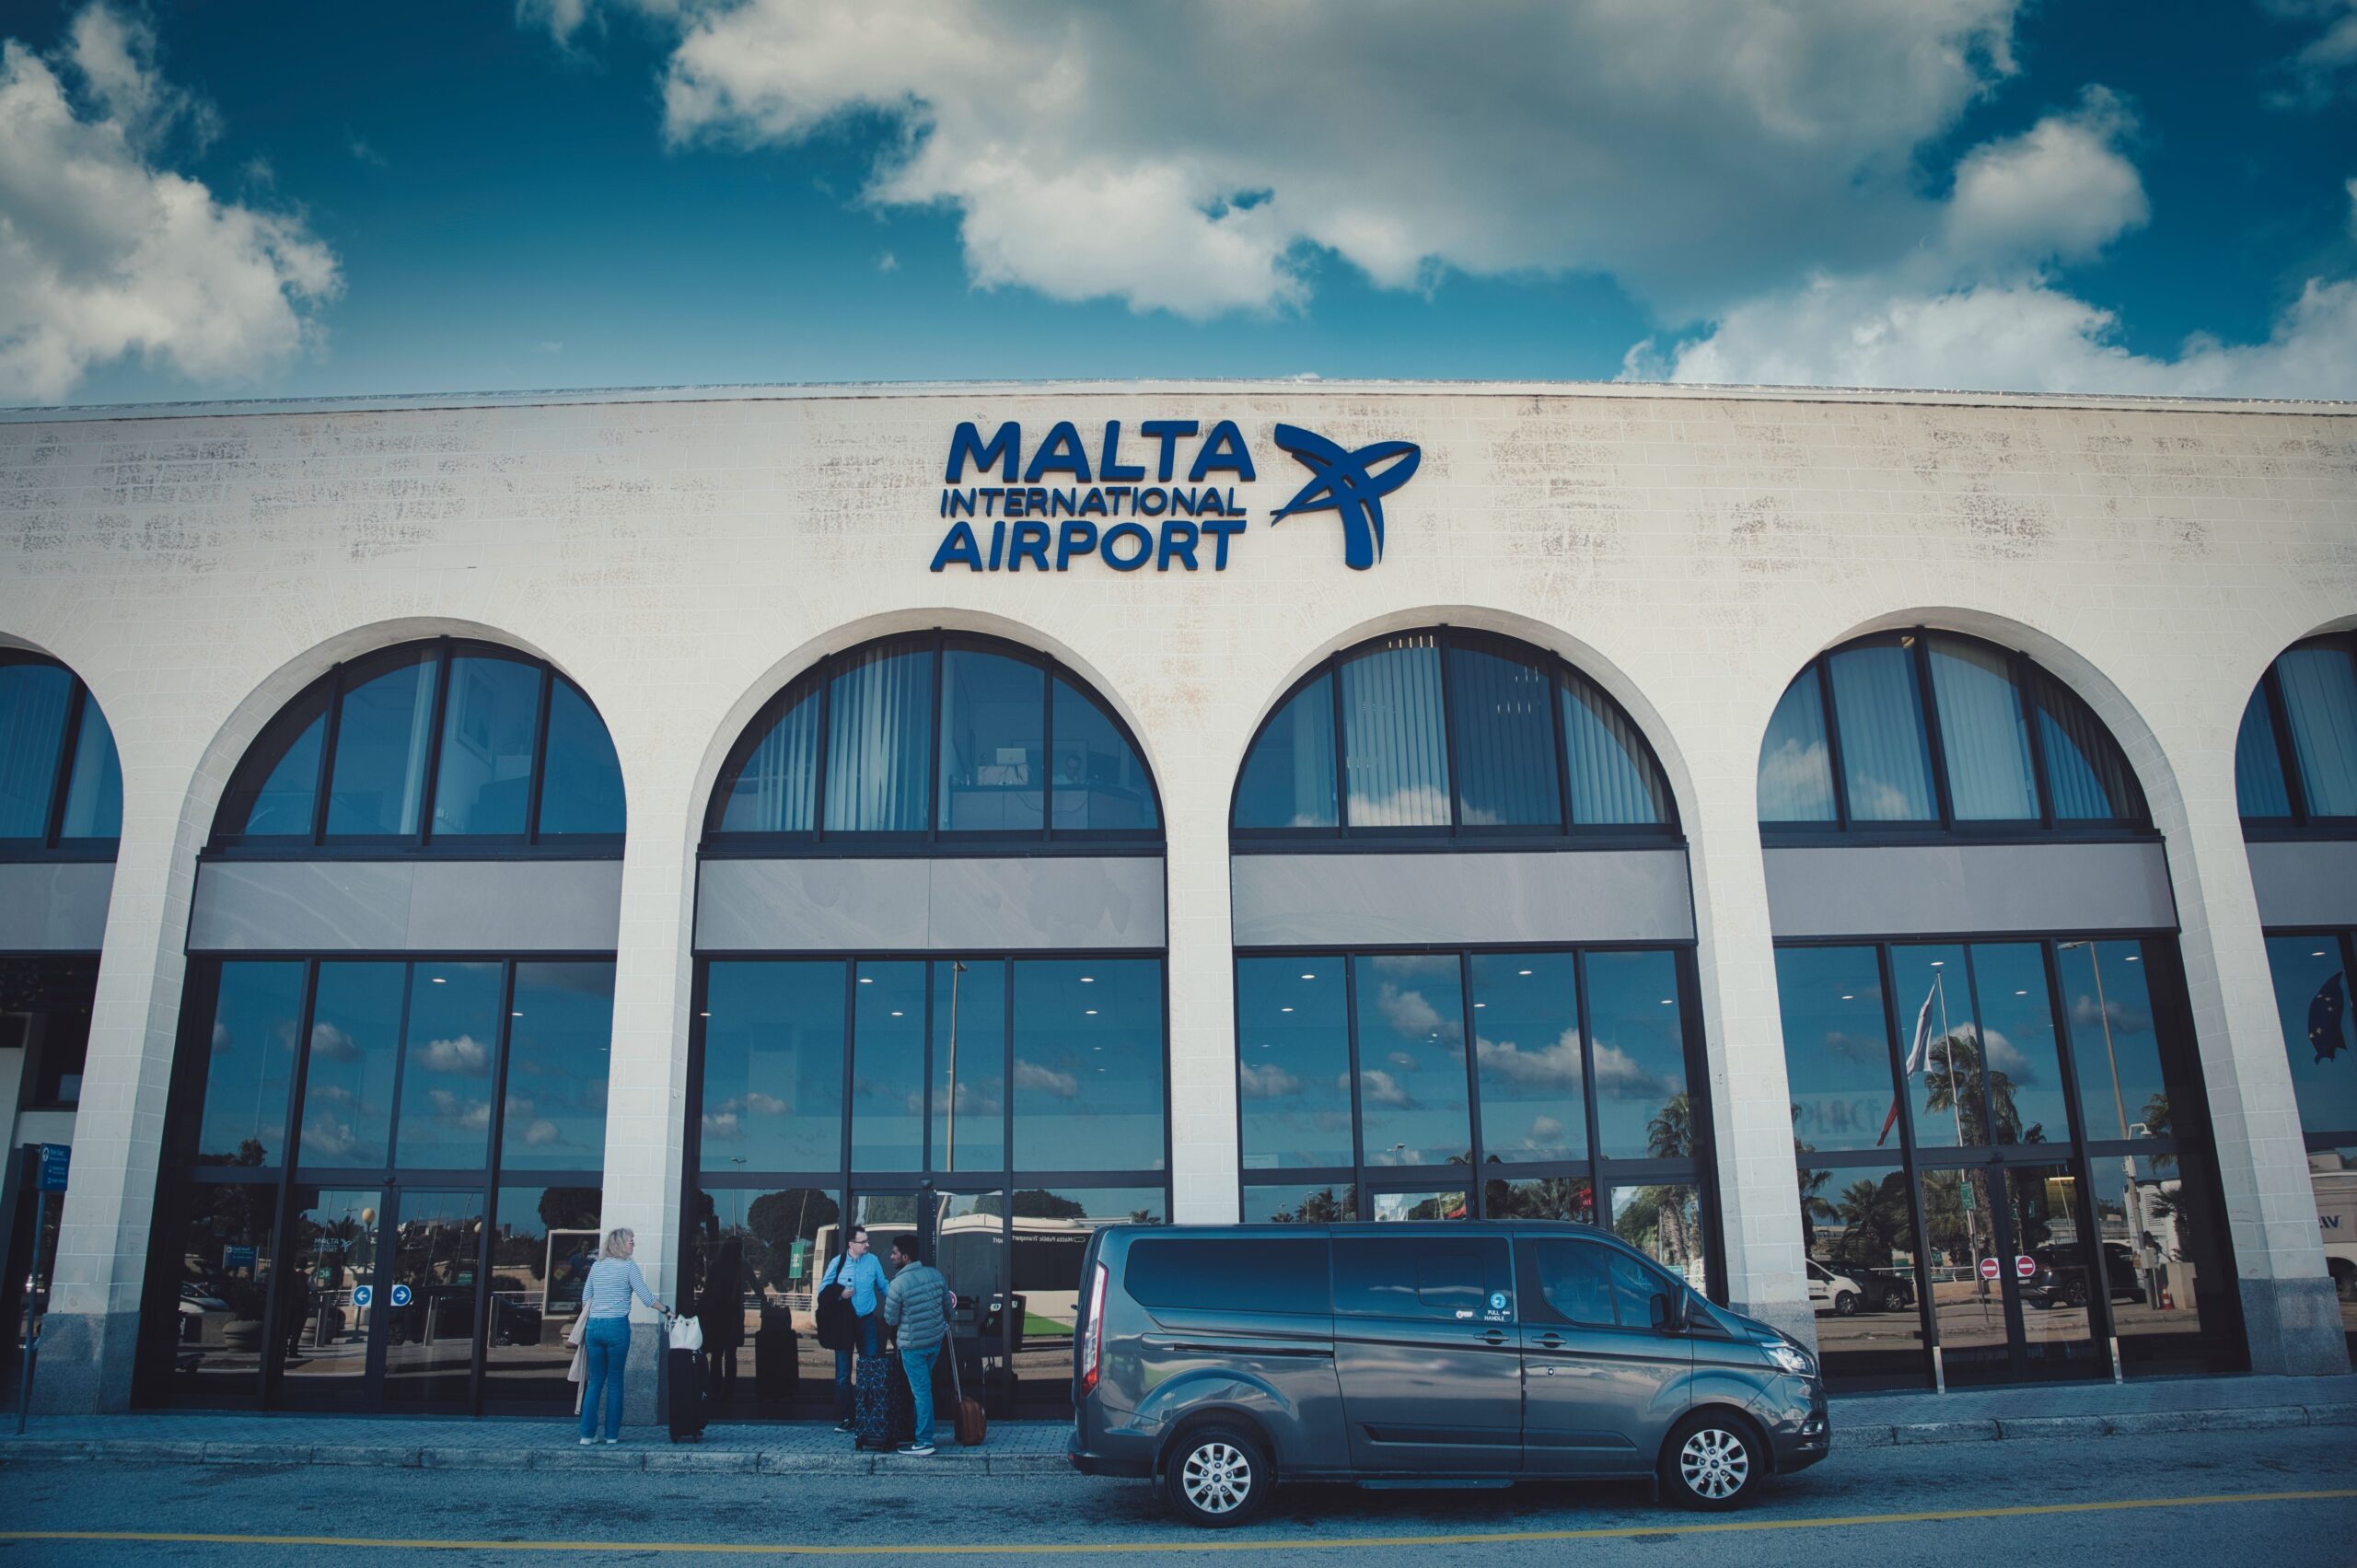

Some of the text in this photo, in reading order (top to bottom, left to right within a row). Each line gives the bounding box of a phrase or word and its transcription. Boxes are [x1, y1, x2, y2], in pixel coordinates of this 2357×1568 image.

[945, 420, 1256, 483] MALTA
[940, 487, 1247, 517] INTERNATIONAL
[930, 520, 1247, 572] AIRPORT
